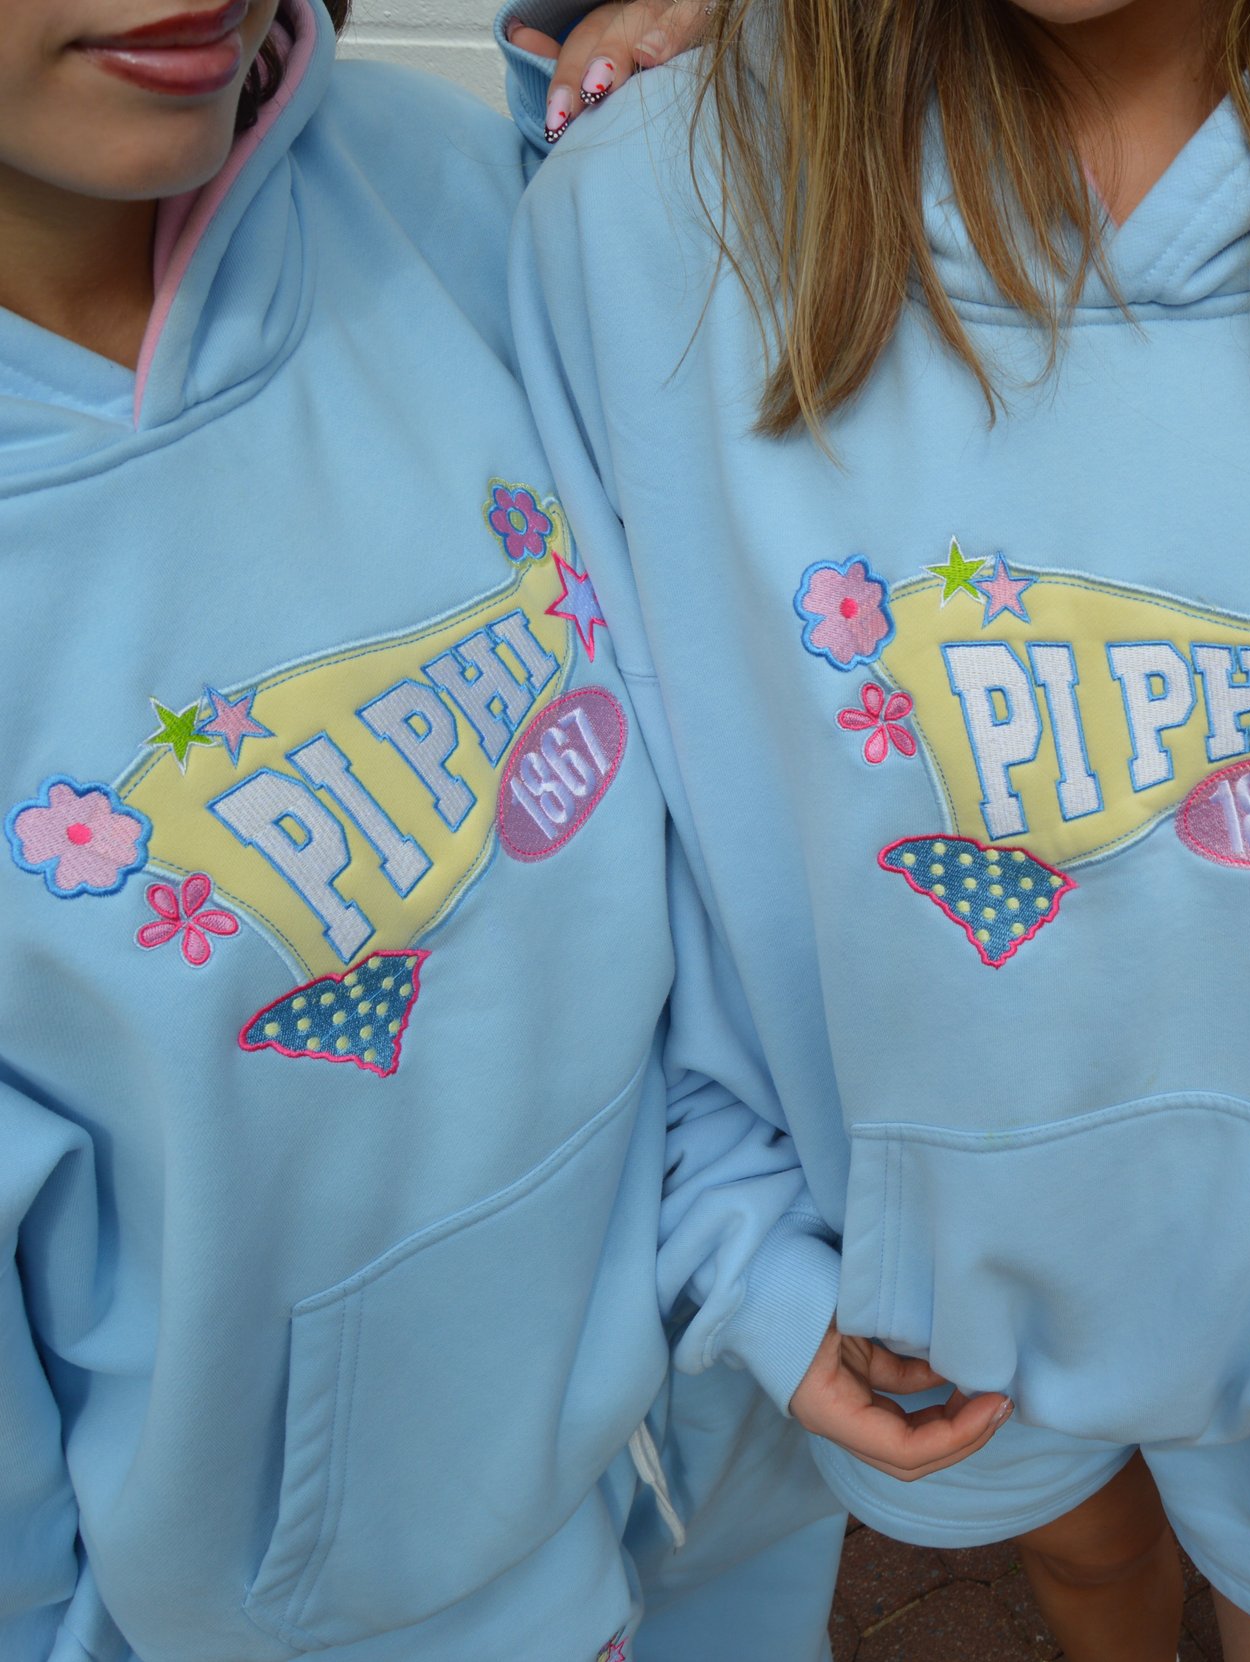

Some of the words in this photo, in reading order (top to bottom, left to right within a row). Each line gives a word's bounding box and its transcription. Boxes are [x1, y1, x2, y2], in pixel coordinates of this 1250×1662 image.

[205, 731, 433, 965] PI
[355, 608, 561, 833] PHI
[511, 707, 612, 841] 1867
[940, 640, 1104, 841] PI
